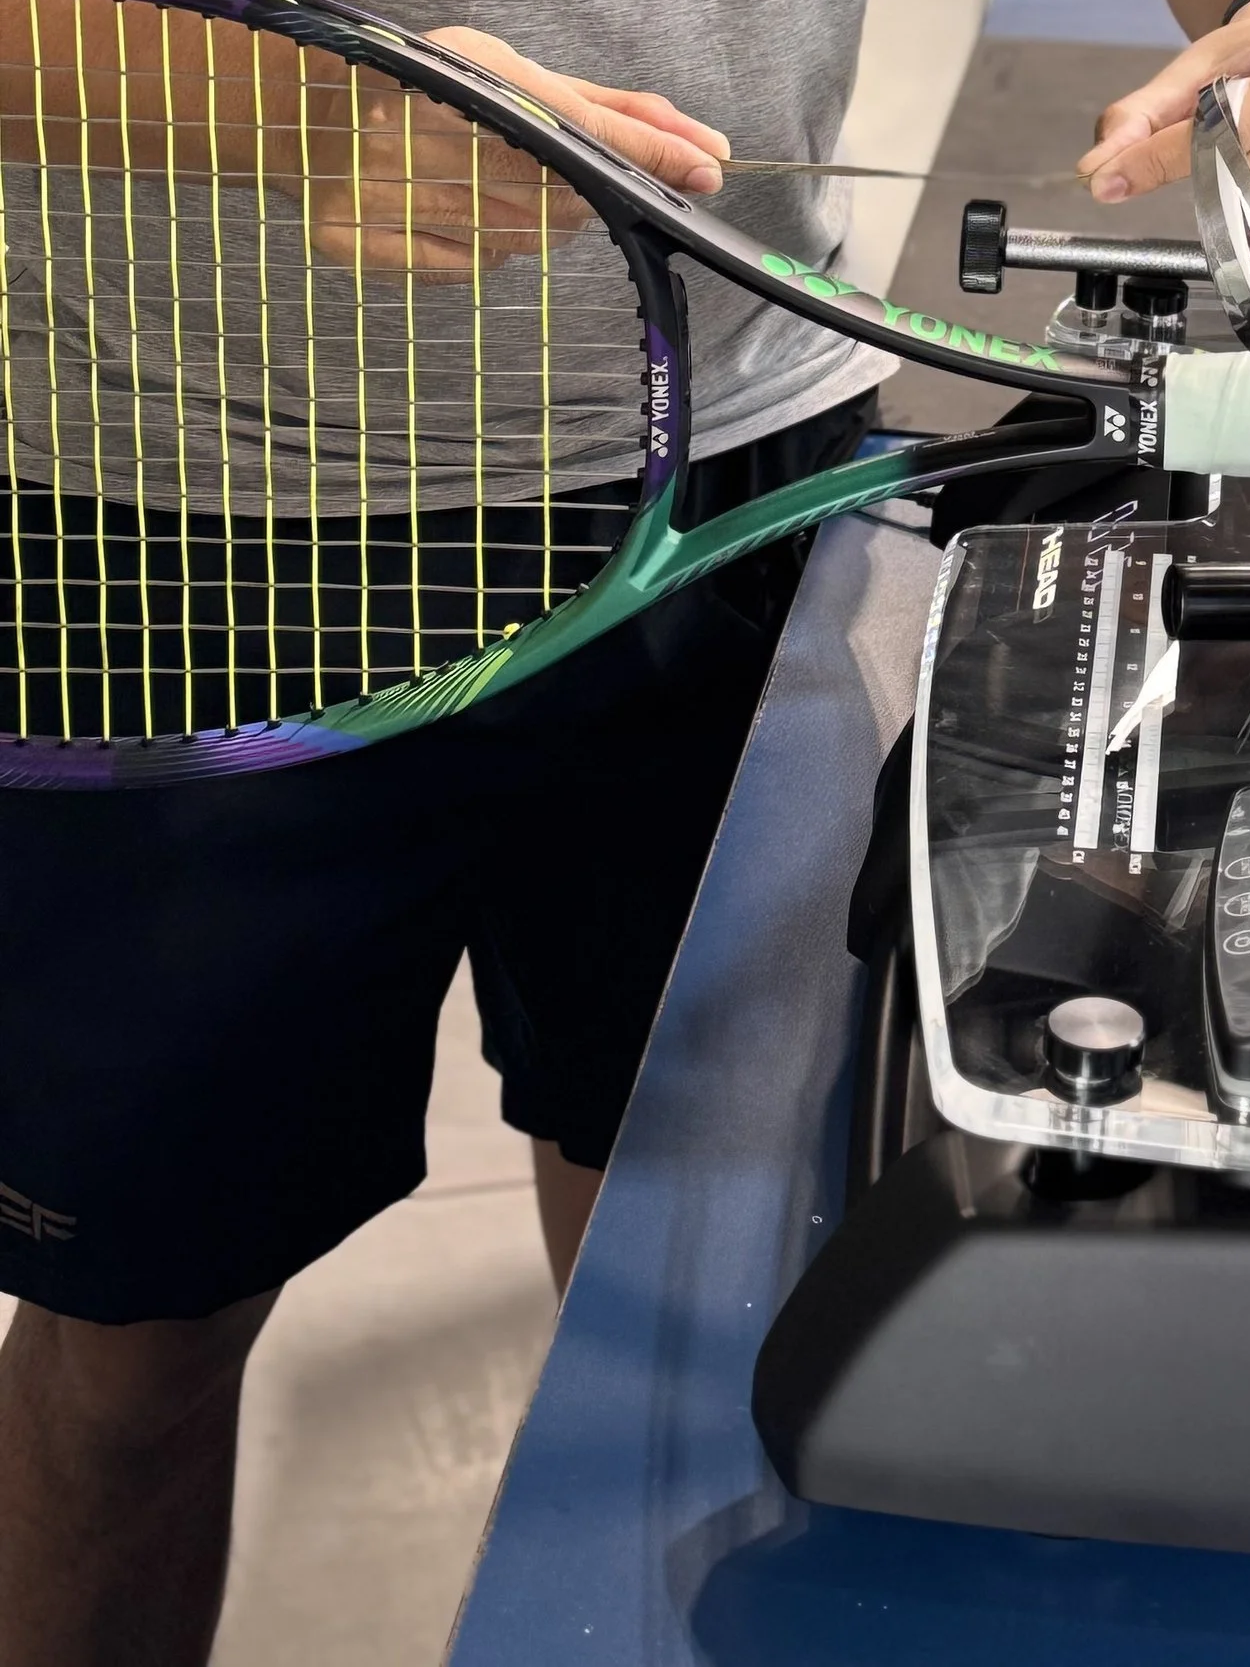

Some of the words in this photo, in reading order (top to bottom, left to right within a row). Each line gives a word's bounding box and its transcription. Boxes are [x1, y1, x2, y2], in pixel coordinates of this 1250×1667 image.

[880, 298, 1064, 372] YONEX
[650, 363, 669, 422] YONEX
[1138, 399, 1158, 454] YONEX
[1032, 526, 1065, 610] HEAD
